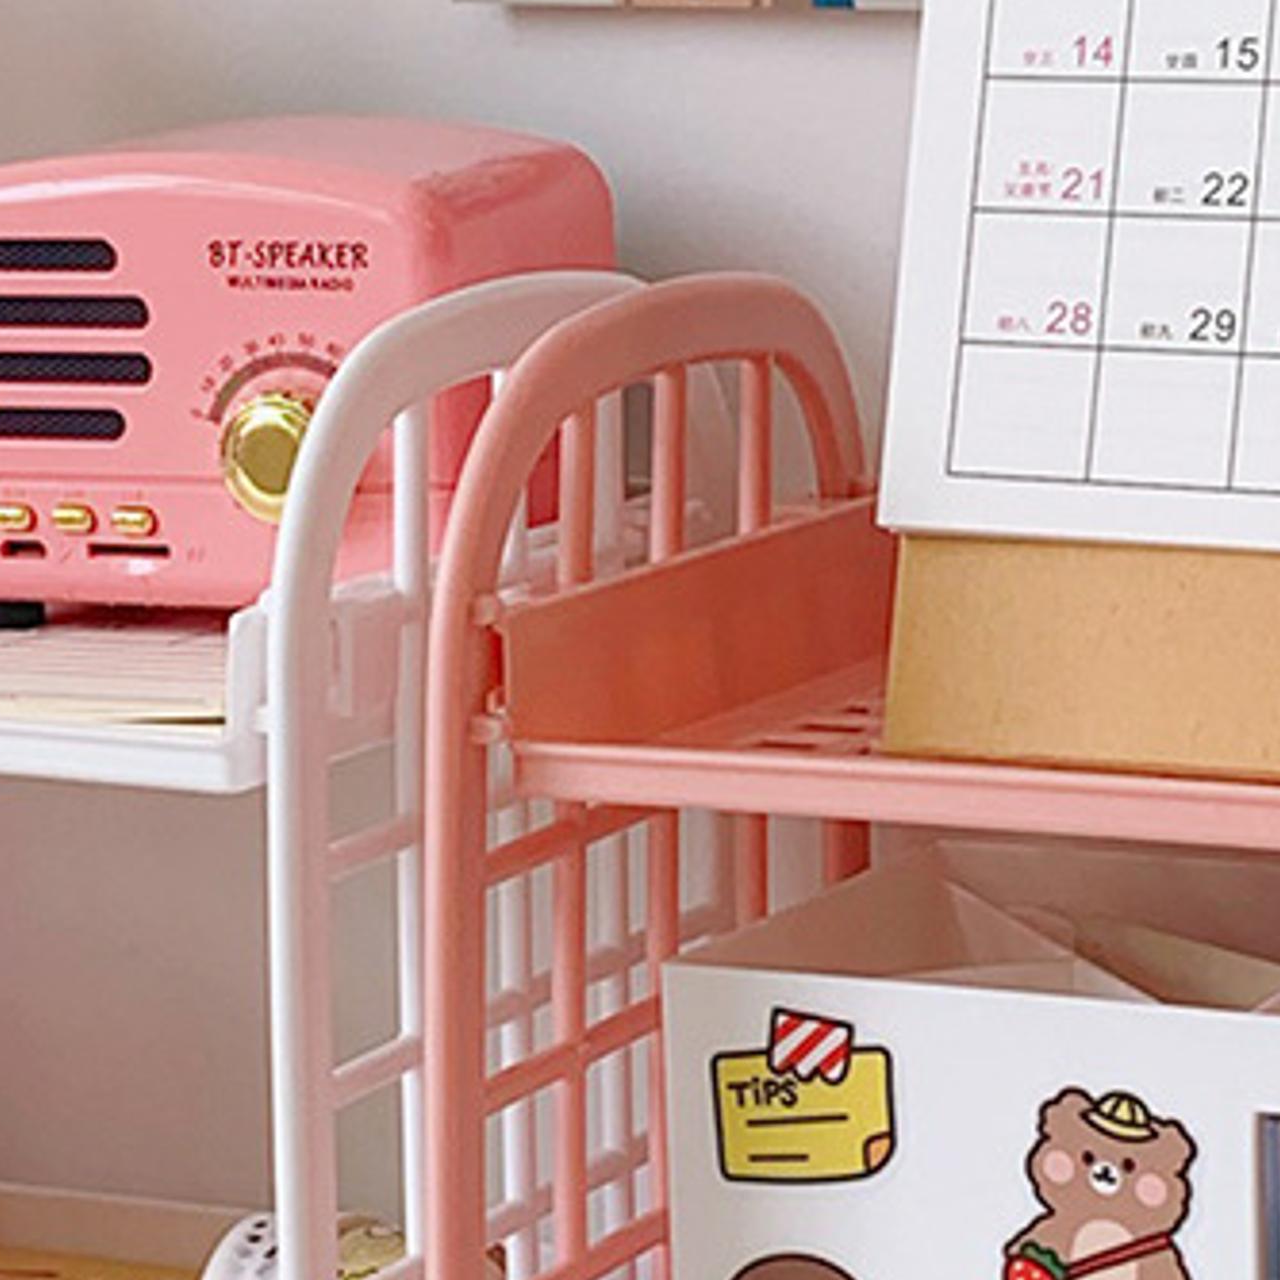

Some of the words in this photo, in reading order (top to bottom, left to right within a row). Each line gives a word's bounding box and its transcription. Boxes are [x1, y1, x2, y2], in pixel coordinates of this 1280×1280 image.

[1074, 35, 1113, 67] 14
[1217, 36, 1260, 72] 15
[1060, 167, 1103, 202] 21
[1201, 171, 1249, 207] 22
[207, 239, 369, 271] BT-SPEAKER
[1045, 300, 1093, 337] 28
[1188, 307, 1237, 343] 29
